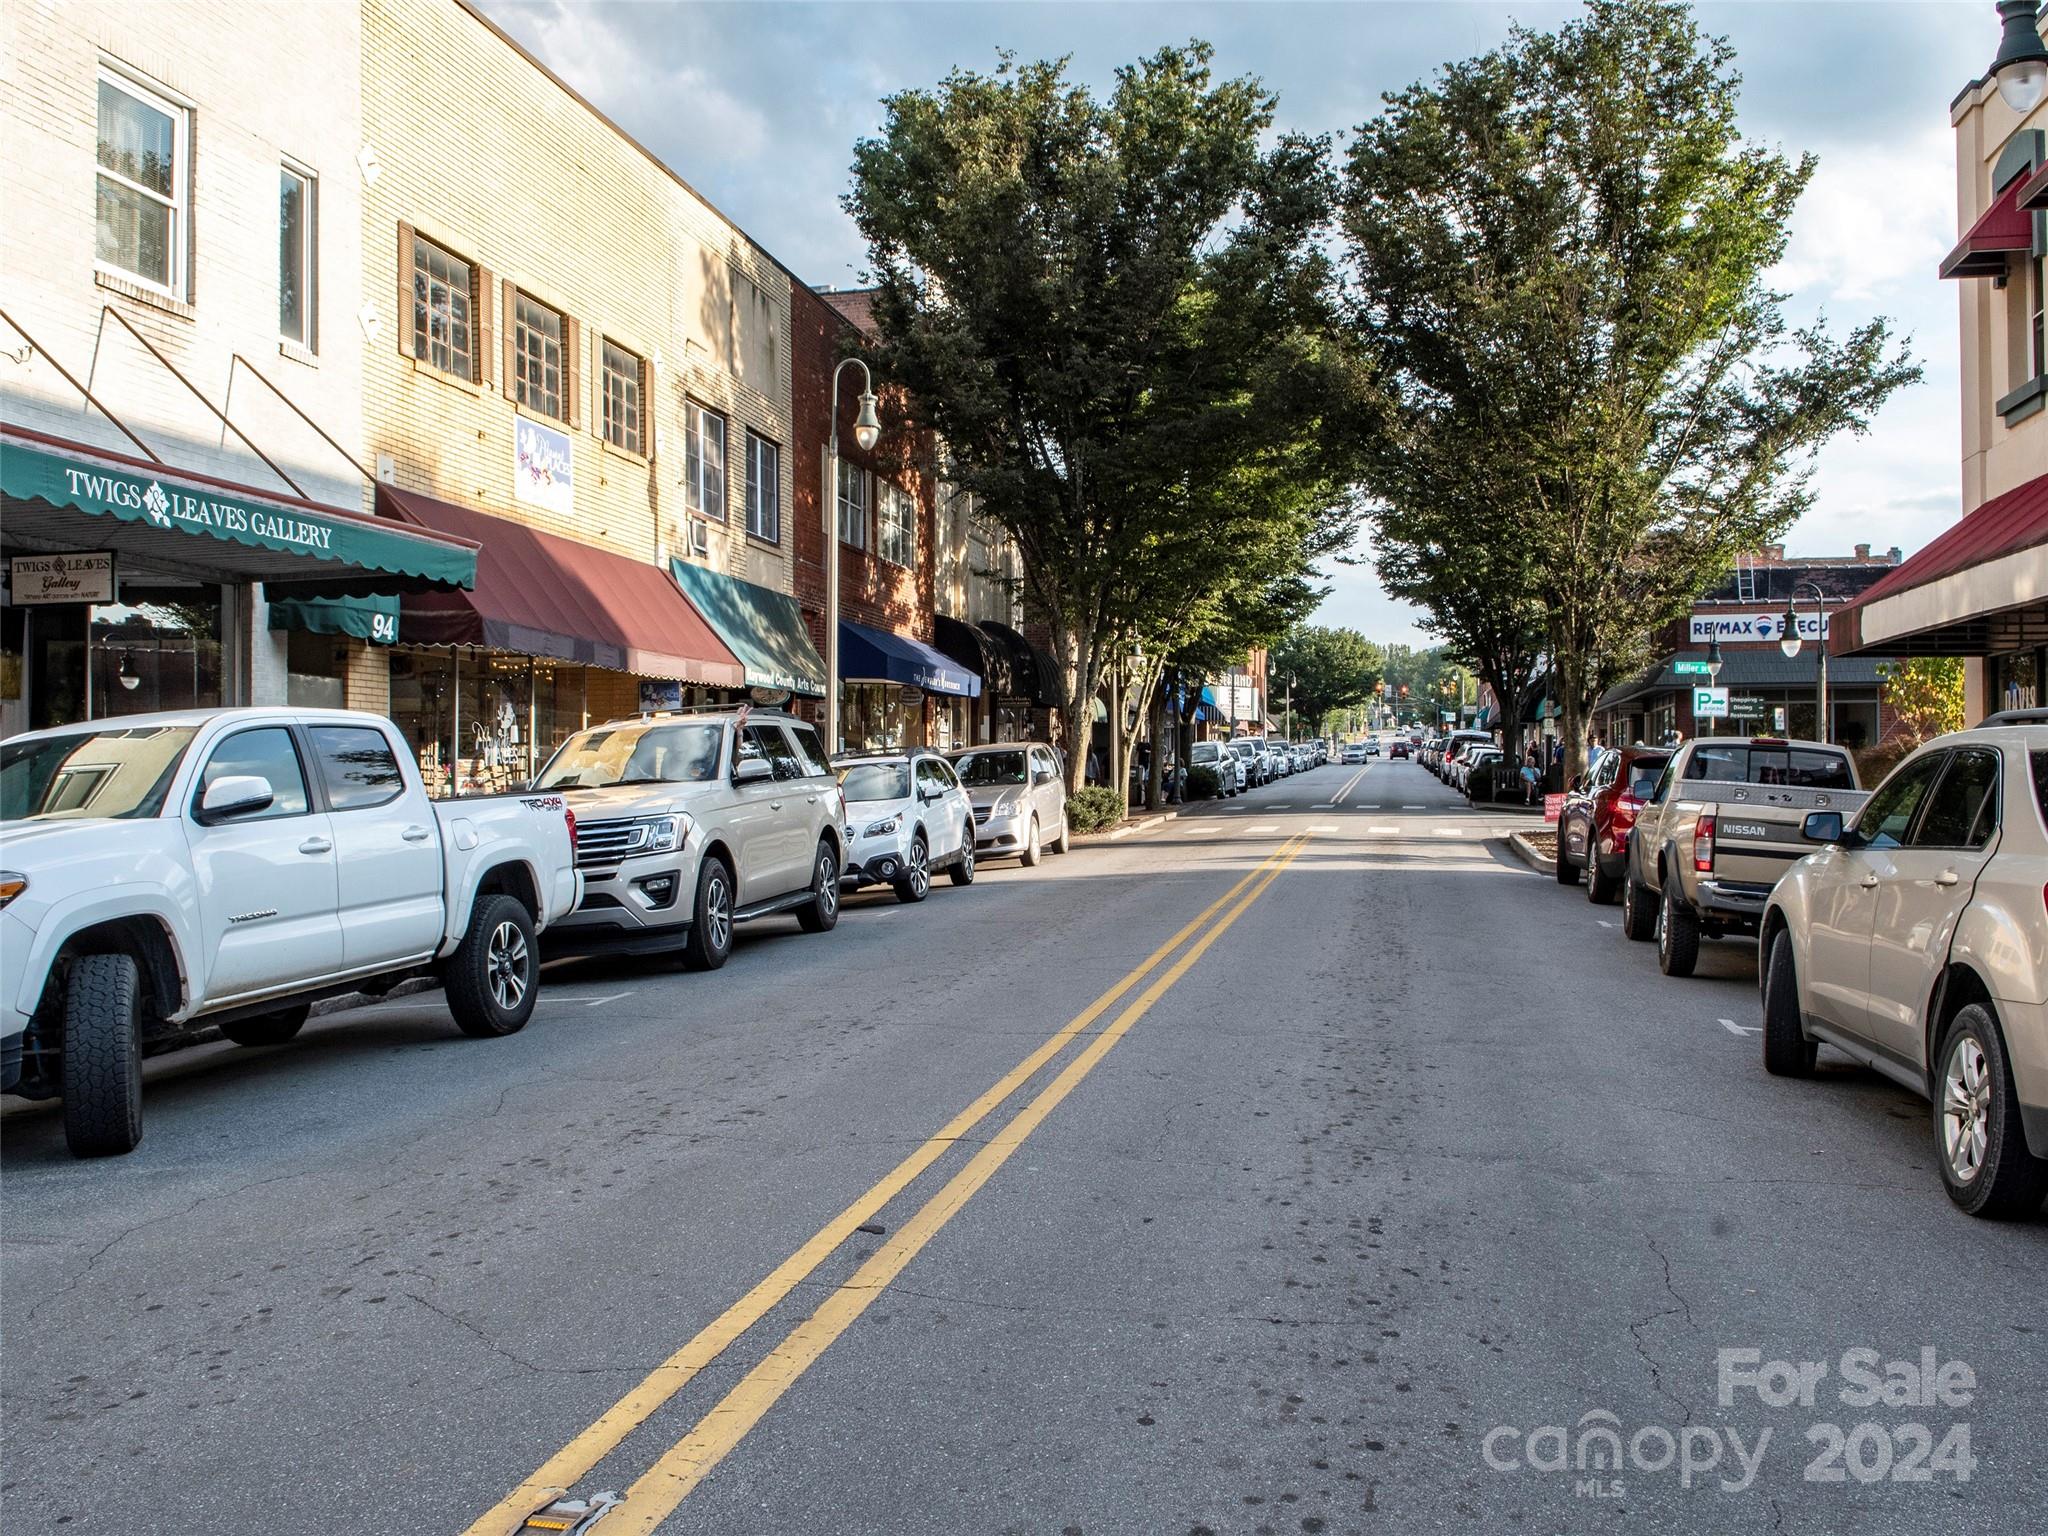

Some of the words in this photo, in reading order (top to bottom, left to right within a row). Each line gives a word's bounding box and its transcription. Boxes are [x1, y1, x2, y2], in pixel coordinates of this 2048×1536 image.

[65, 468, 142, 509] TWIGS
[171, 493, 248, 532] LEAVES
[251, 512, 332, 549] GALLERY
[15, 561, 51, 573] TWIGS
[67, 558, 110, 570] LEAVES
[42, 576, 80, 592] Gallery
[372, 613, 394, 640] 94
[1677, 663, 1698, 673] Miller
[775, 672, 796, 690] County
[797, 676, 809, 691] Arts
[2005, 686, 2036, 711] DAVIS
[1723, 824, 1766, 836] NISSAN
